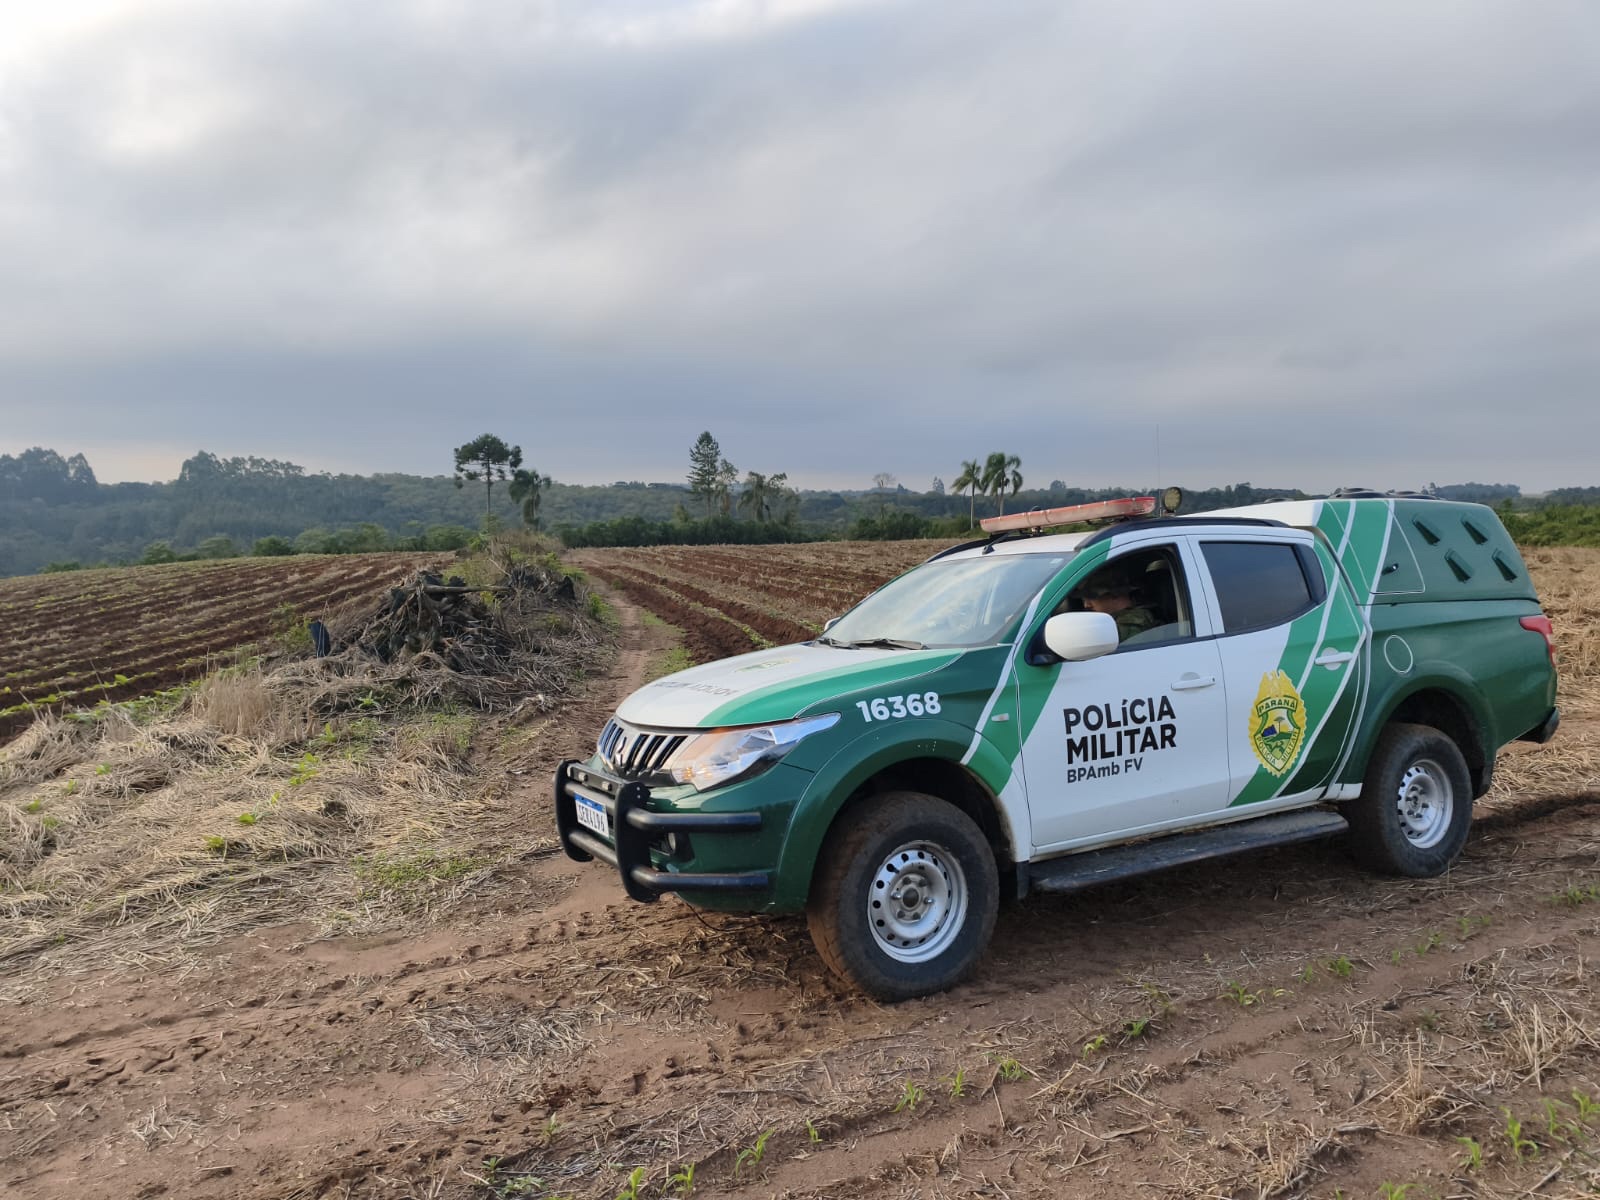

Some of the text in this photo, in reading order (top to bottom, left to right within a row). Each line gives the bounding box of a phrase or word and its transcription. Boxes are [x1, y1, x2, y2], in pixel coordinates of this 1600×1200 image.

[855, 691, 941, 723] 16368
[1063, 695, 1176, 735] POLÍCIA
[1066, 723, 1177, 765] MILITAR
[1067, 756, 1144, 784] BPAmb FV
